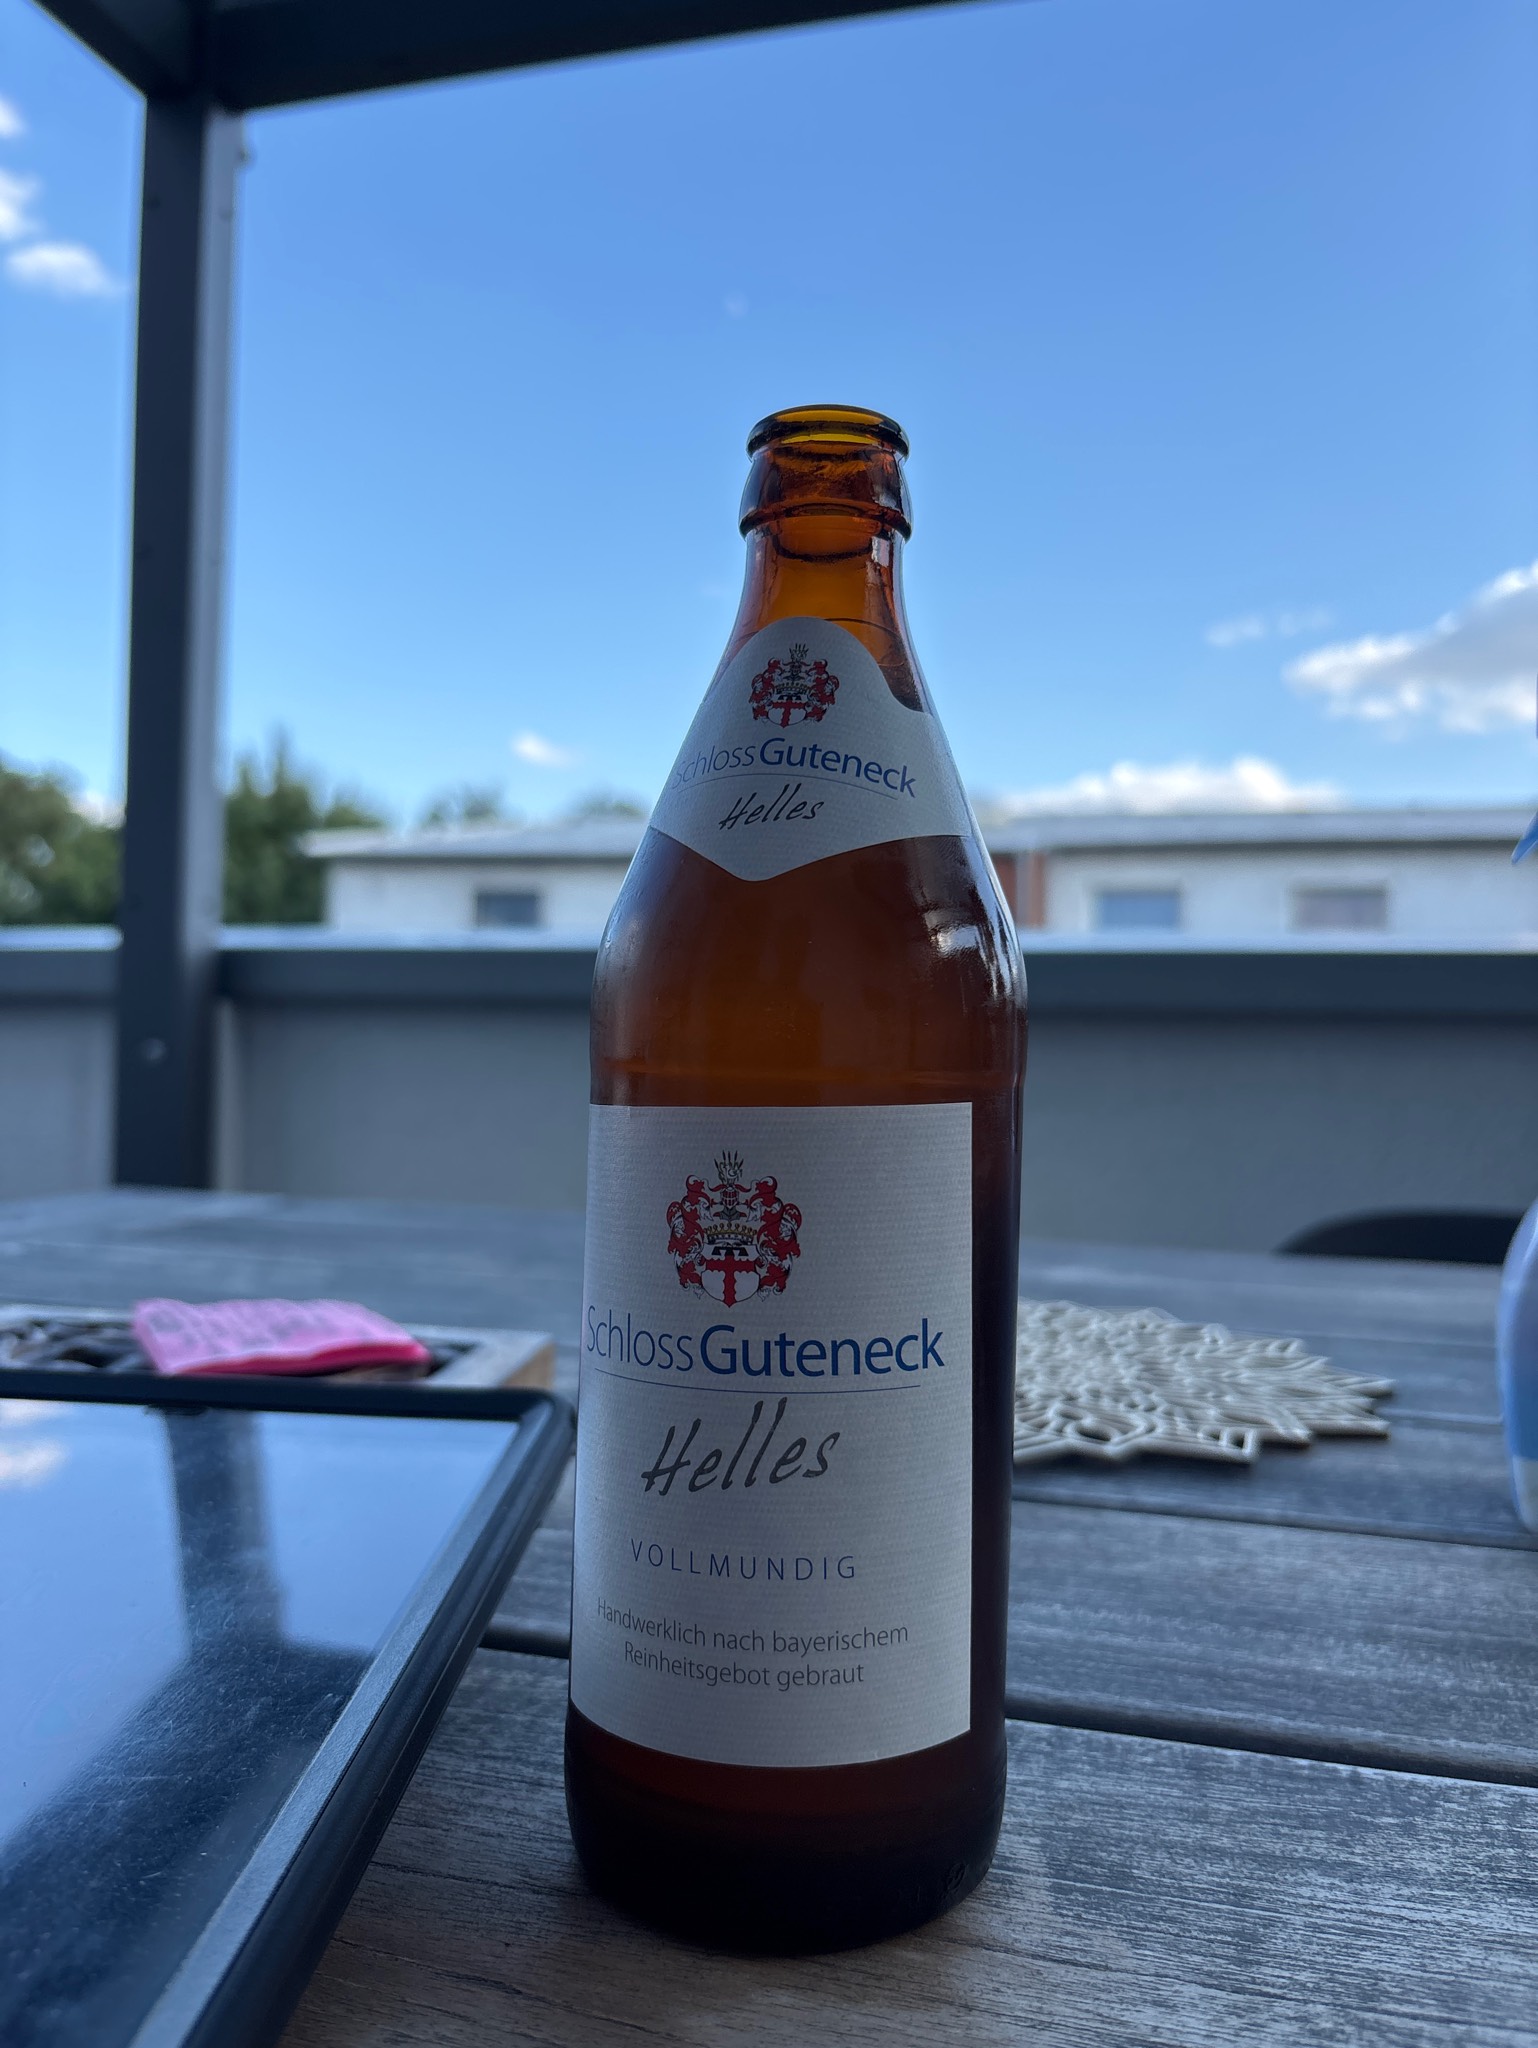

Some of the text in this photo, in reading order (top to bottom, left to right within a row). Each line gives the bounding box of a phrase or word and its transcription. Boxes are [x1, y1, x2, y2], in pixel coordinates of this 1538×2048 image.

[718, 783, 825, 831] Helles
[640, 1396, 841, 1496] Helles
[630, 1537, 856, 1581] VOLLMUNDIG
[597, 1596, 909, 1659] Handwerklich nach bayerischem
[624, 1640, 865, 1692] Reinheitsgebot gebraut
